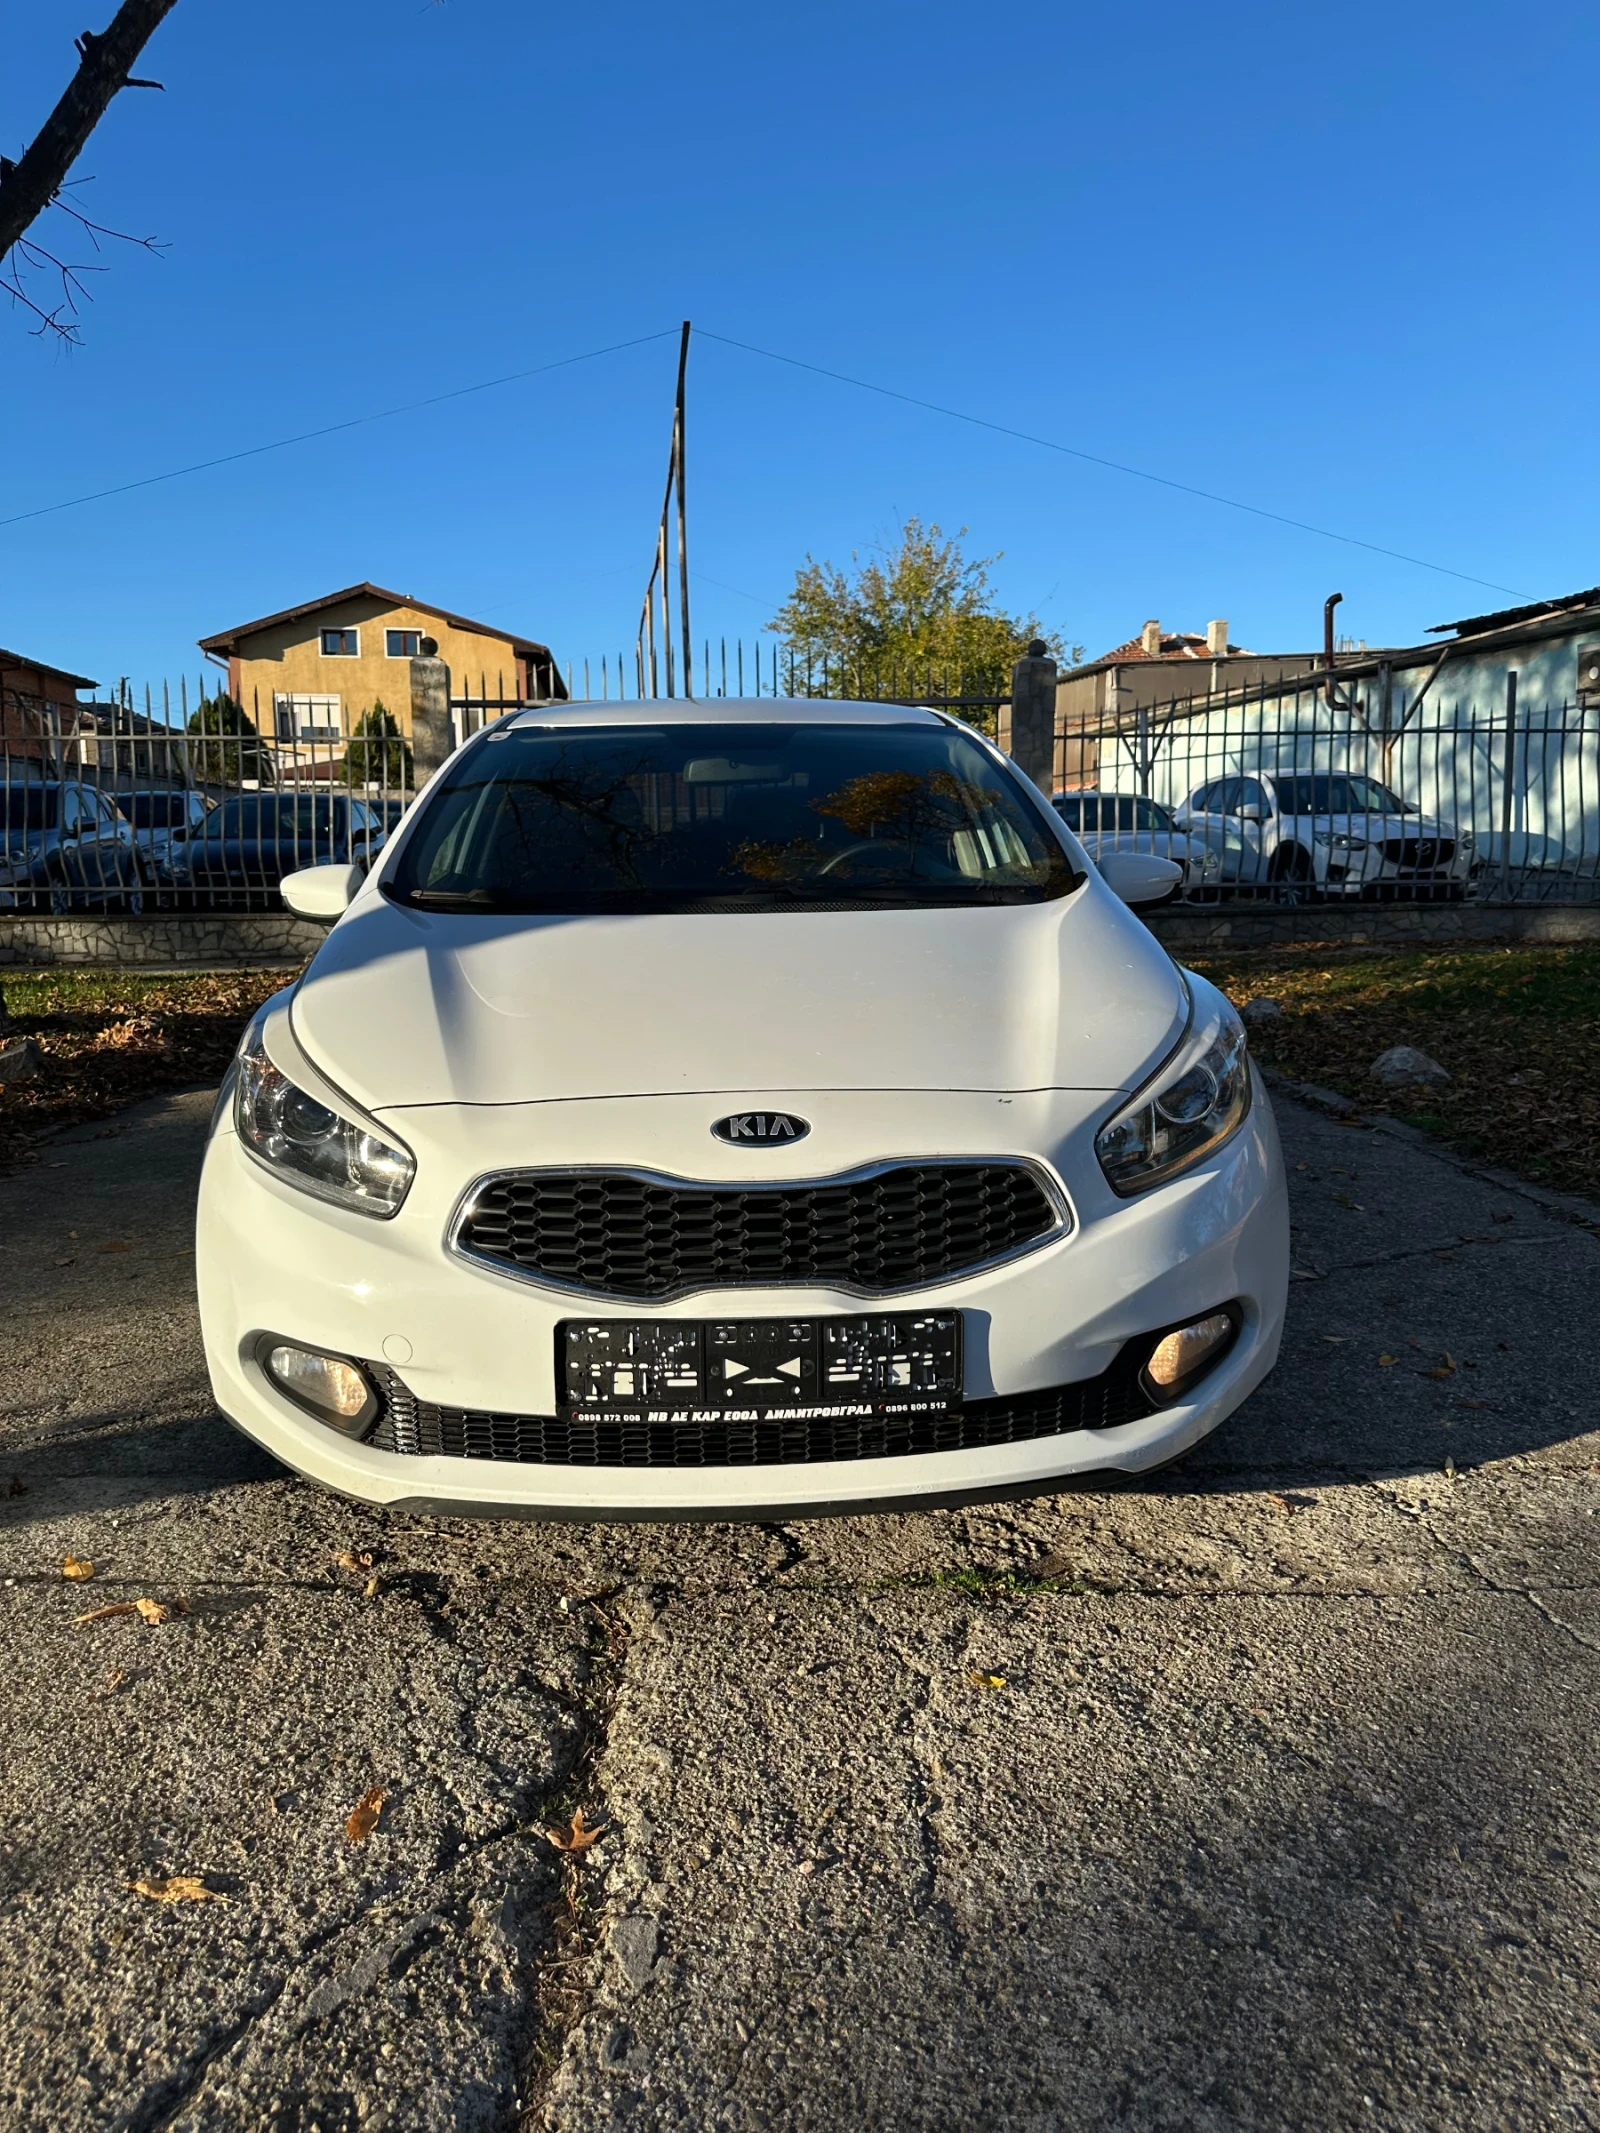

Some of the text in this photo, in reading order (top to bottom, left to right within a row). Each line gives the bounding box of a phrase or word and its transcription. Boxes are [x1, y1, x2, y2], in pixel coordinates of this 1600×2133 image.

[729, 1116, 795, 1138] KIA
[578, 1413, 602, 1422] 0898
[603, 1413, 621, 1422] 572
[647, 1411, 669, 1422] ИВ
[671, 1411, 689, 1422] ДЕ
[691, 1411, 721, 1422] КАР
[723, 1410, 759, 1421] ЕООД
[764, 1405, 873, 1420] ДИМИТРОВГРАД
[885, 1404, 908, 1413] 0896
[910, 1403, 928, 1412] 800
[930, 1401, 947, 1410] 512
